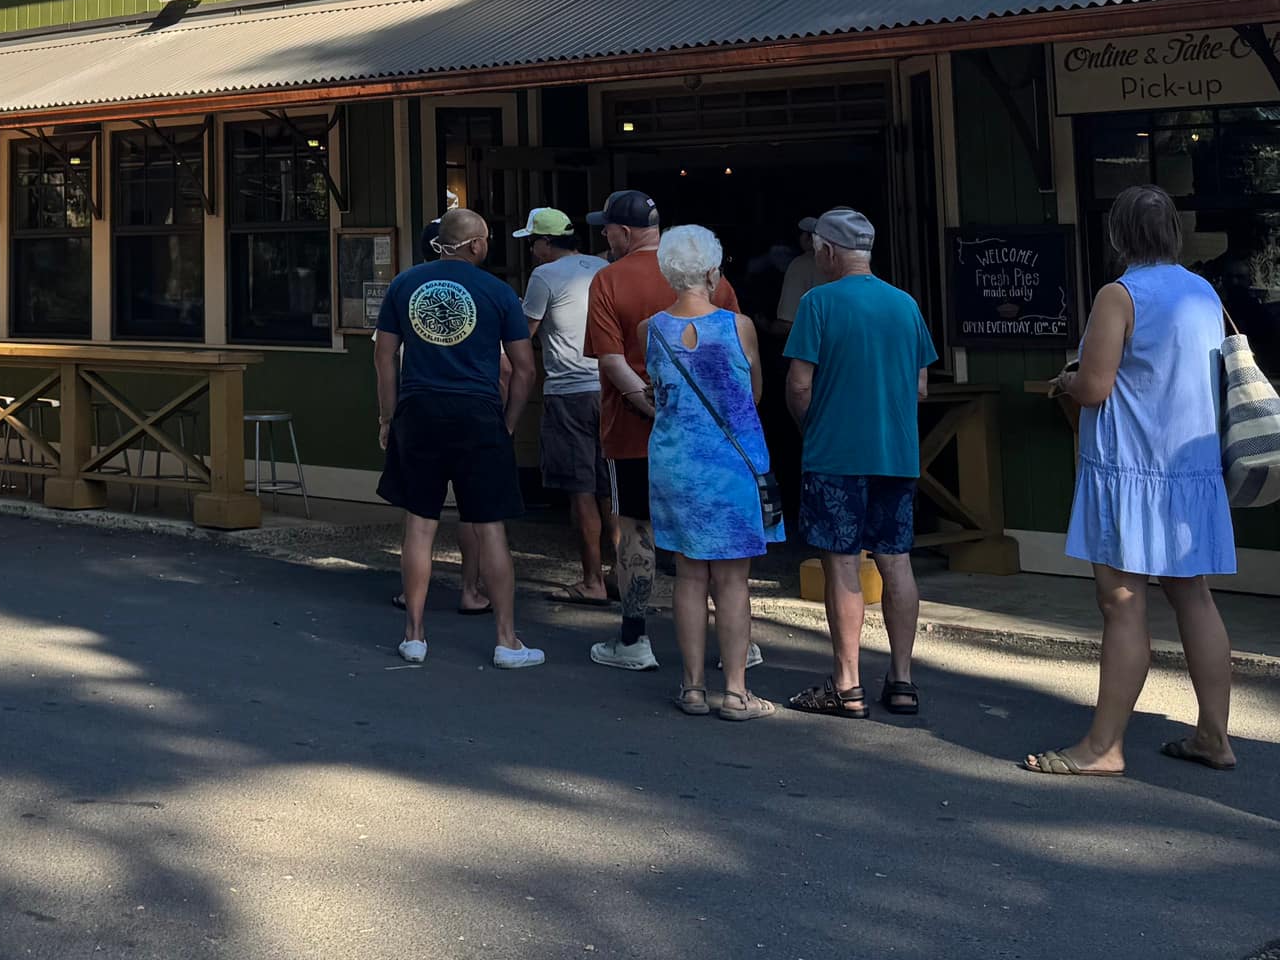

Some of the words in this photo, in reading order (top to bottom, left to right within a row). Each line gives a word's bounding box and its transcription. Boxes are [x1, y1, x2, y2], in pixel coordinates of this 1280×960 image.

[1064, 43, 1138, 72] Online
[1144, 48, 1159, 65] &
[1121, 73, 1223, 101] Pick-up
[976, 248, 1039, 267] WELCOME!
[976, 267, 1010, 287] Fresh
[1014, 268, 1040, 287] Pies
[983, 286, 1007, 297] made
[1009, 285, 1033, 302] daily
[962, 320, 985, 334] OPEN
